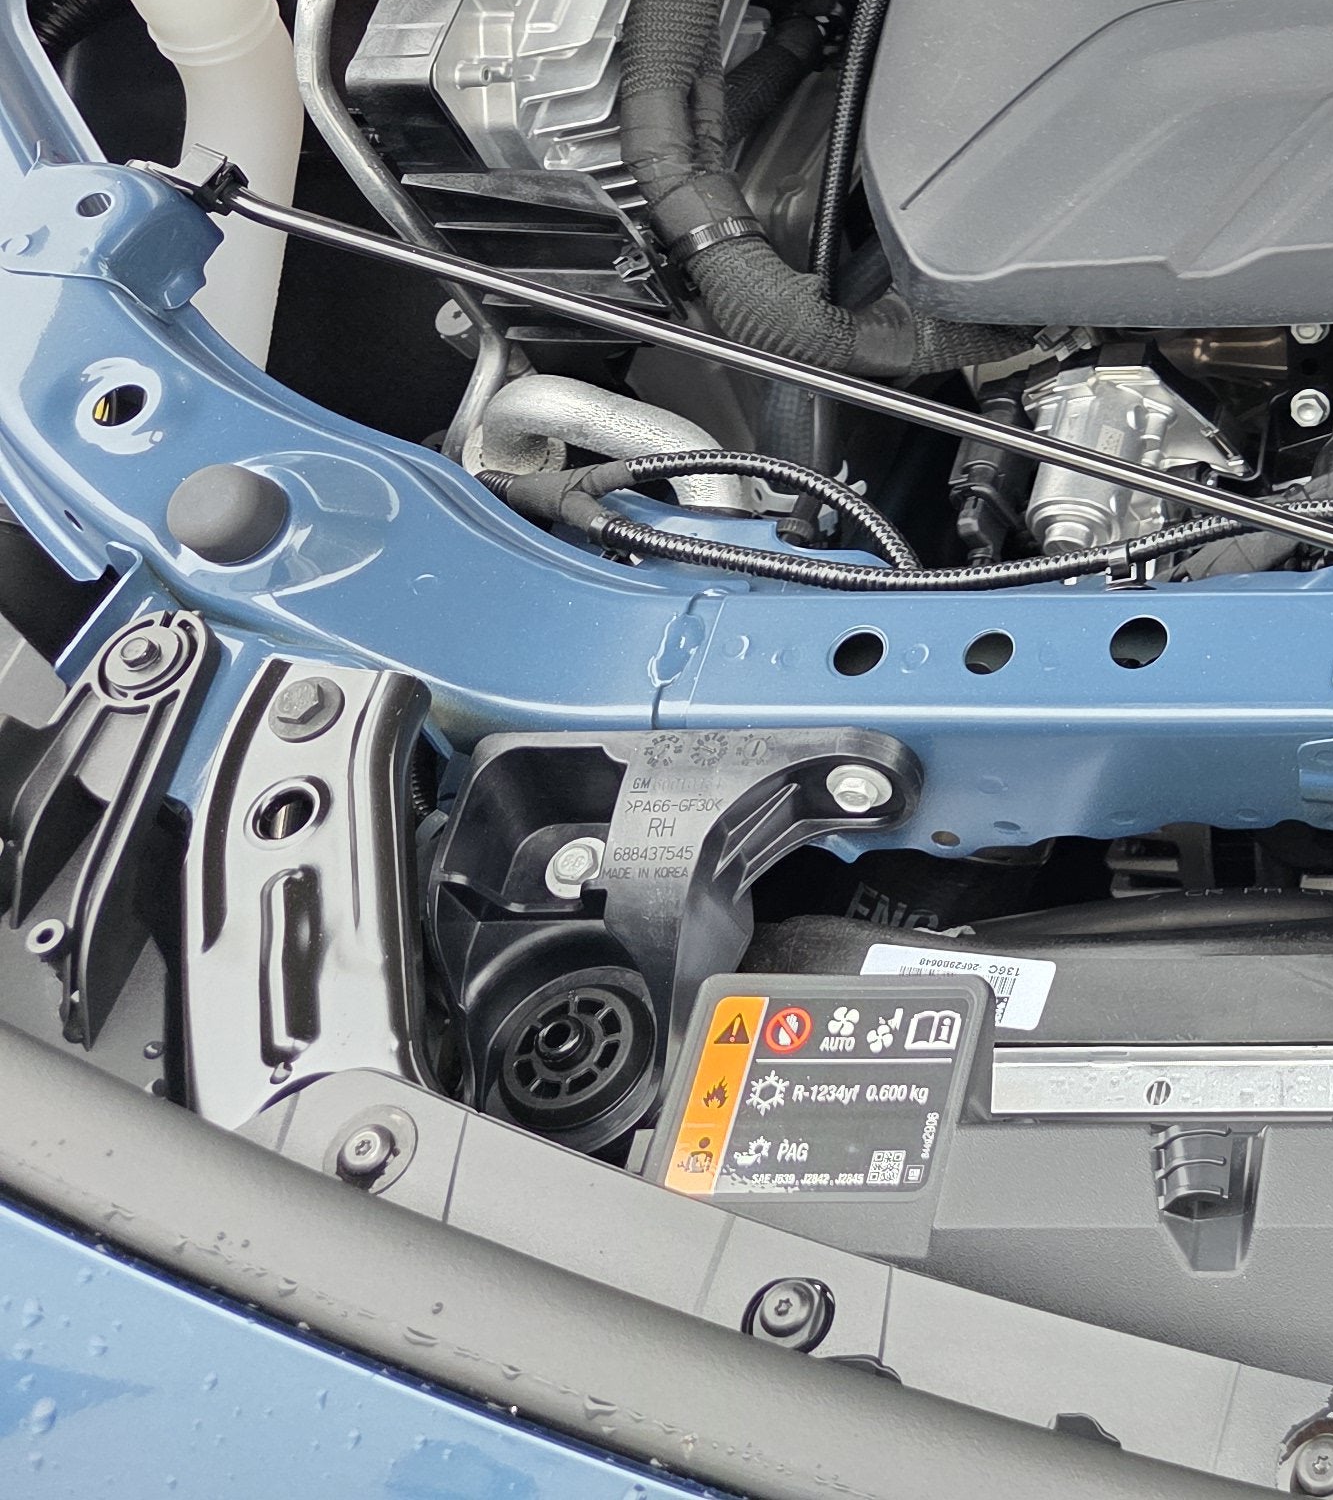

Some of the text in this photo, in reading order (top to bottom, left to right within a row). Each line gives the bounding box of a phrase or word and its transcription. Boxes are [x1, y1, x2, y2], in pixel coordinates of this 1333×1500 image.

[632, 777, 651, 790] GM
[625, 798, 724, 814] >PA66-GF30<
[647, 817, 677, 838] RH
[613, 845, 694, 861] 688437545
[601, 866, 689, 879] MADE IN KOREA
[819, 1036, 856, 1051] AUTO
[792, 1084, 929, 1105] R-1234yf 0.600 kg
[777, 1142, 809, 1162] PAG
[751, 1173, 771, 1184] SAE
